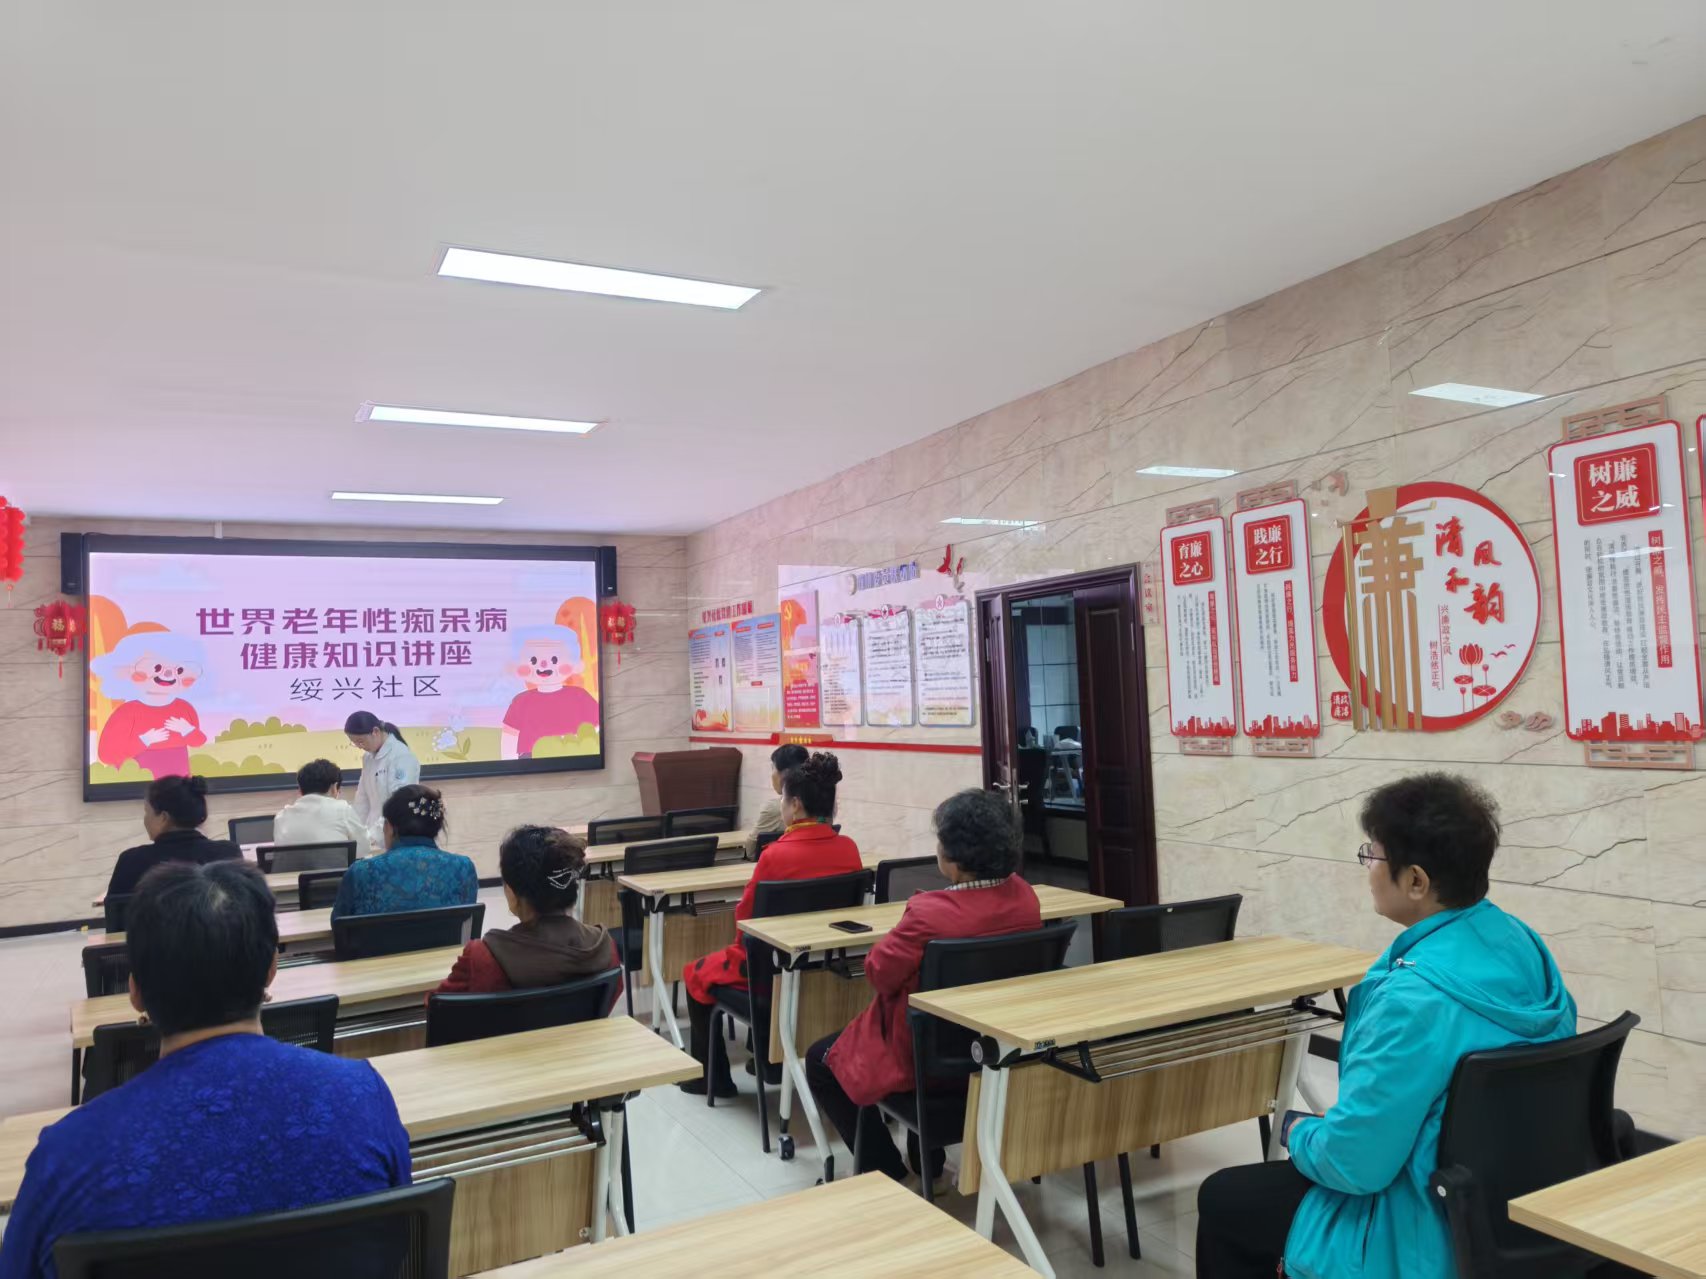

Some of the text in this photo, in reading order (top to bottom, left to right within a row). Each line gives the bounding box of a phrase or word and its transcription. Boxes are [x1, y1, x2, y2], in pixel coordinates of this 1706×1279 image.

[1588, 457, 1637, 487] 树廉
[1590, 485, 1640, 512] 之威
[1254, 526, 1281, 545] 践廉
[1179, 541, 1202, 560] 育廉
[1256, 546, 1282, 565] 之行
[1180, 561, 1203, 578] 之心
[196, 607, 508, 635] 世界老年性痴呆病
[240, 640, 473, 670] 健康知识讲座
[289, 675, 442, 701] 绥兴社区
